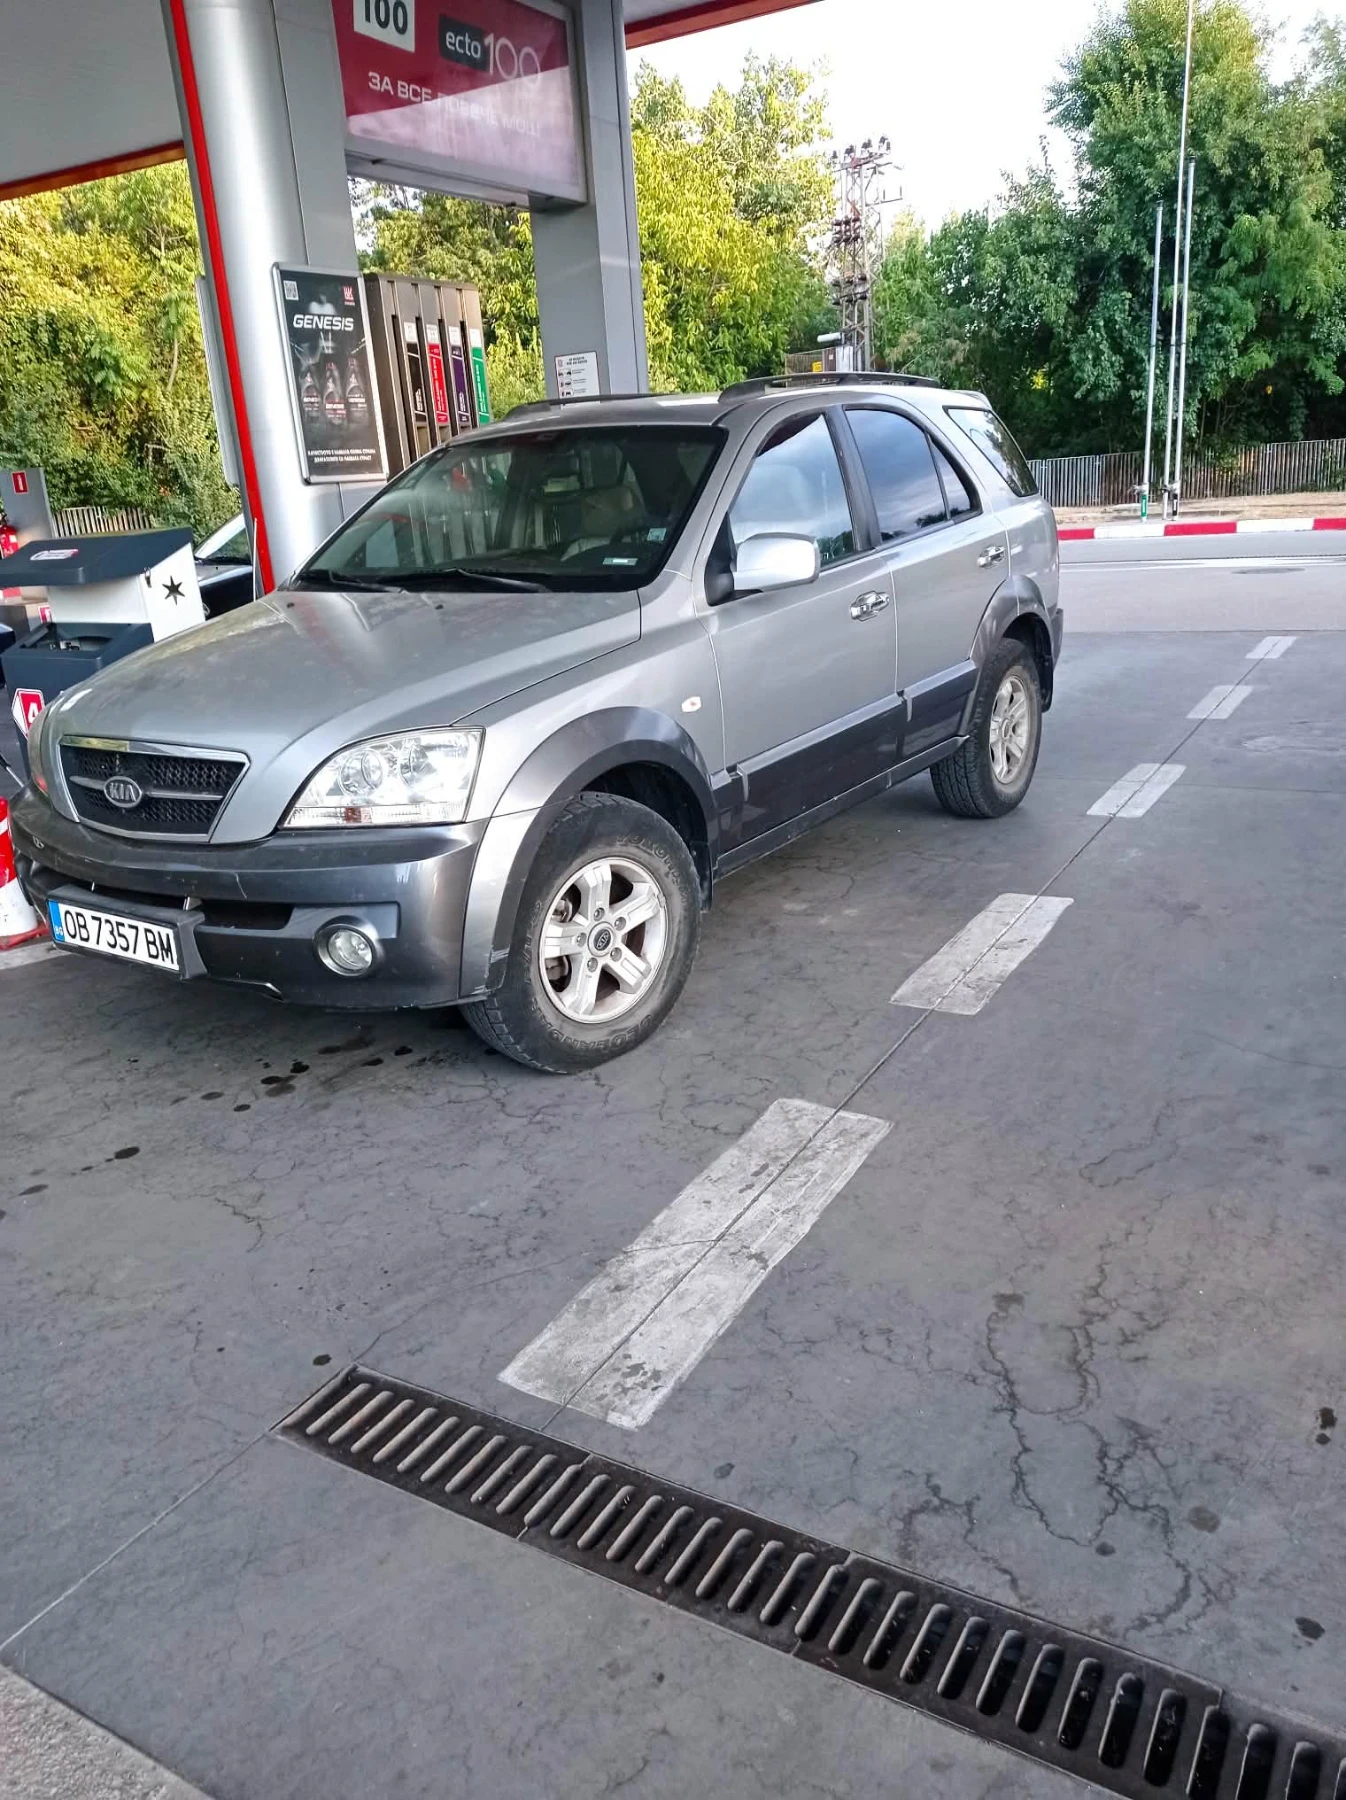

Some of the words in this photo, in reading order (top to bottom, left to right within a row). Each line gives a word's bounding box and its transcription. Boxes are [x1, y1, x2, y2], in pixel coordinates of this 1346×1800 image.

[364, 0, 408, 35] 100
[445, 31, 482, 59] ecto
[368, 71, 394, 95] ЗА
[397, 80, 432, 104] ВСЕ
[293, 314, 354, 332] GENESIS
[109, 782, 137, 802] KIA
[64, 910, 90, 942] OB
[91, 915, 139, 954] 7357
[144, 928, 174, 964] BM
